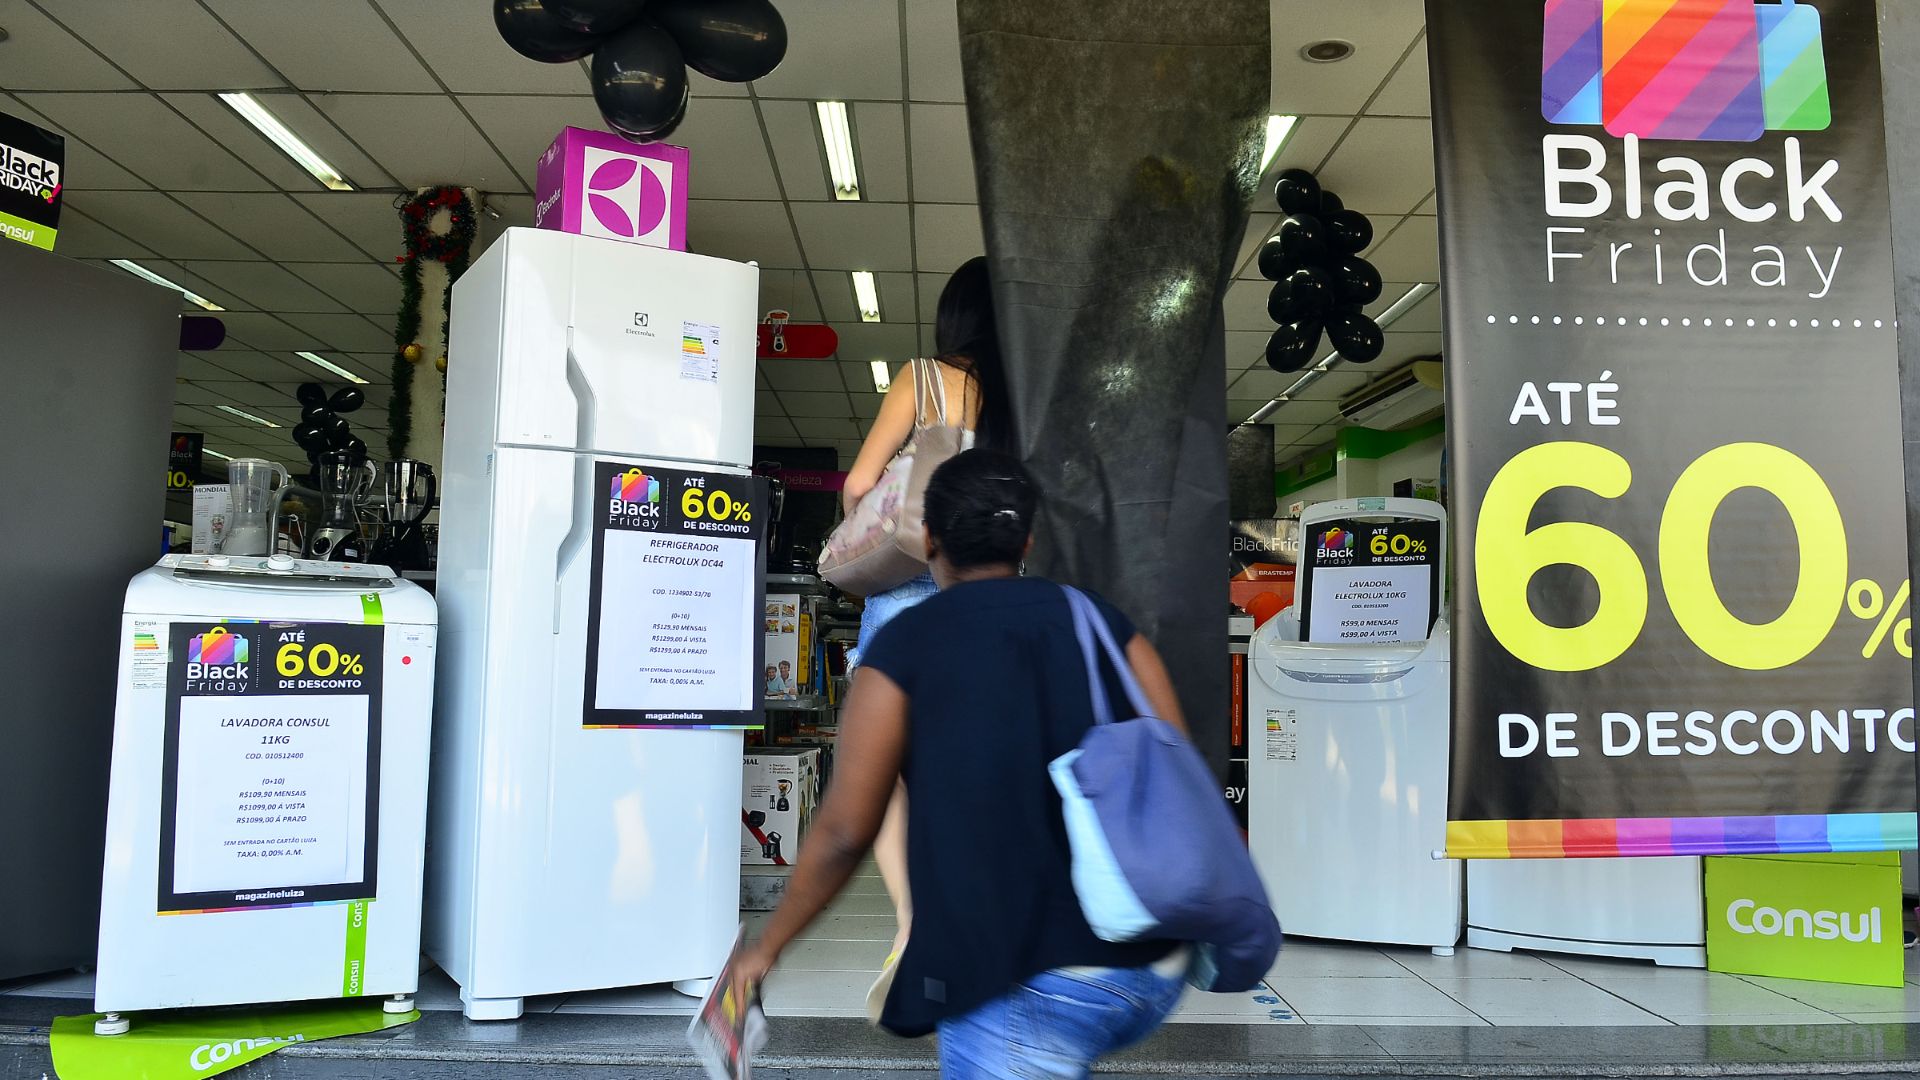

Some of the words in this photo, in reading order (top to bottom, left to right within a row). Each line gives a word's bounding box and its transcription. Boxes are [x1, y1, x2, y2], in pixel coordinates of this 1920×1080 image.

[0, 171, 43, 197] RIDAY
[1543, 132, 1843, 223] Black
[0, 221, 35, 242] onsul
[1546, 227, 1843, 299] Friday
[625, 327, 656, 338] Electrolux
[1509, 370, 1621, 426] ATÉ
[683, 477, 706, 488] ATÉ
[610, 499, 660, 517] Black
[681, 488, 752, 522] 60%
[609, 514, 659, 529] Friday
[683, 521, 697, 529] DE
[699, 522, 750, 534] DESCONTO
[1371, 527, 1388, 535] ATÉ
[650, 539, 719, 552] REFRIGERADOR
[1370, 534, 1427, 555] 60%
[1316, 547, 1354, 558] Black
[1475, 441, 1913, 672] 60%
[642, 554, 700, 567] ELECTROLUX
[701, 558, 724, 568] DC44
[1348, 580, 1393, 588] LAVADORA
[1335, 592, 1384, 600] ELECTROLUX
[278, 630, 306, 643] ATÉ
[275, 643, 364, 677] 60%
[187, 662, 249, 679] Black
[186, 680, 248, 693] Friday
[279, 680, 295, 689] DE
[298, 679, 362, 689] DESCONTO
[220, 718, 283, 728] LAVADORA
[286, 718, 331, 728] CONSUL
[645, 712, 703, 721] magazineluiza
[1498, 713, 1579, 758] DE
[1601, 708, 1916, 757] DESCONTO
[261, 735, 290, 745] 11KG
[262, 777, 285, 786] (0+10)
[282, 815, 307, 823] PRAZO
[237, 850, 260, 858] TAXA:
[235, 889, 305, 902] magazineluiza
[1726, 898, 1882, 944] Consul
[349, 960, 360, 995] Consul
